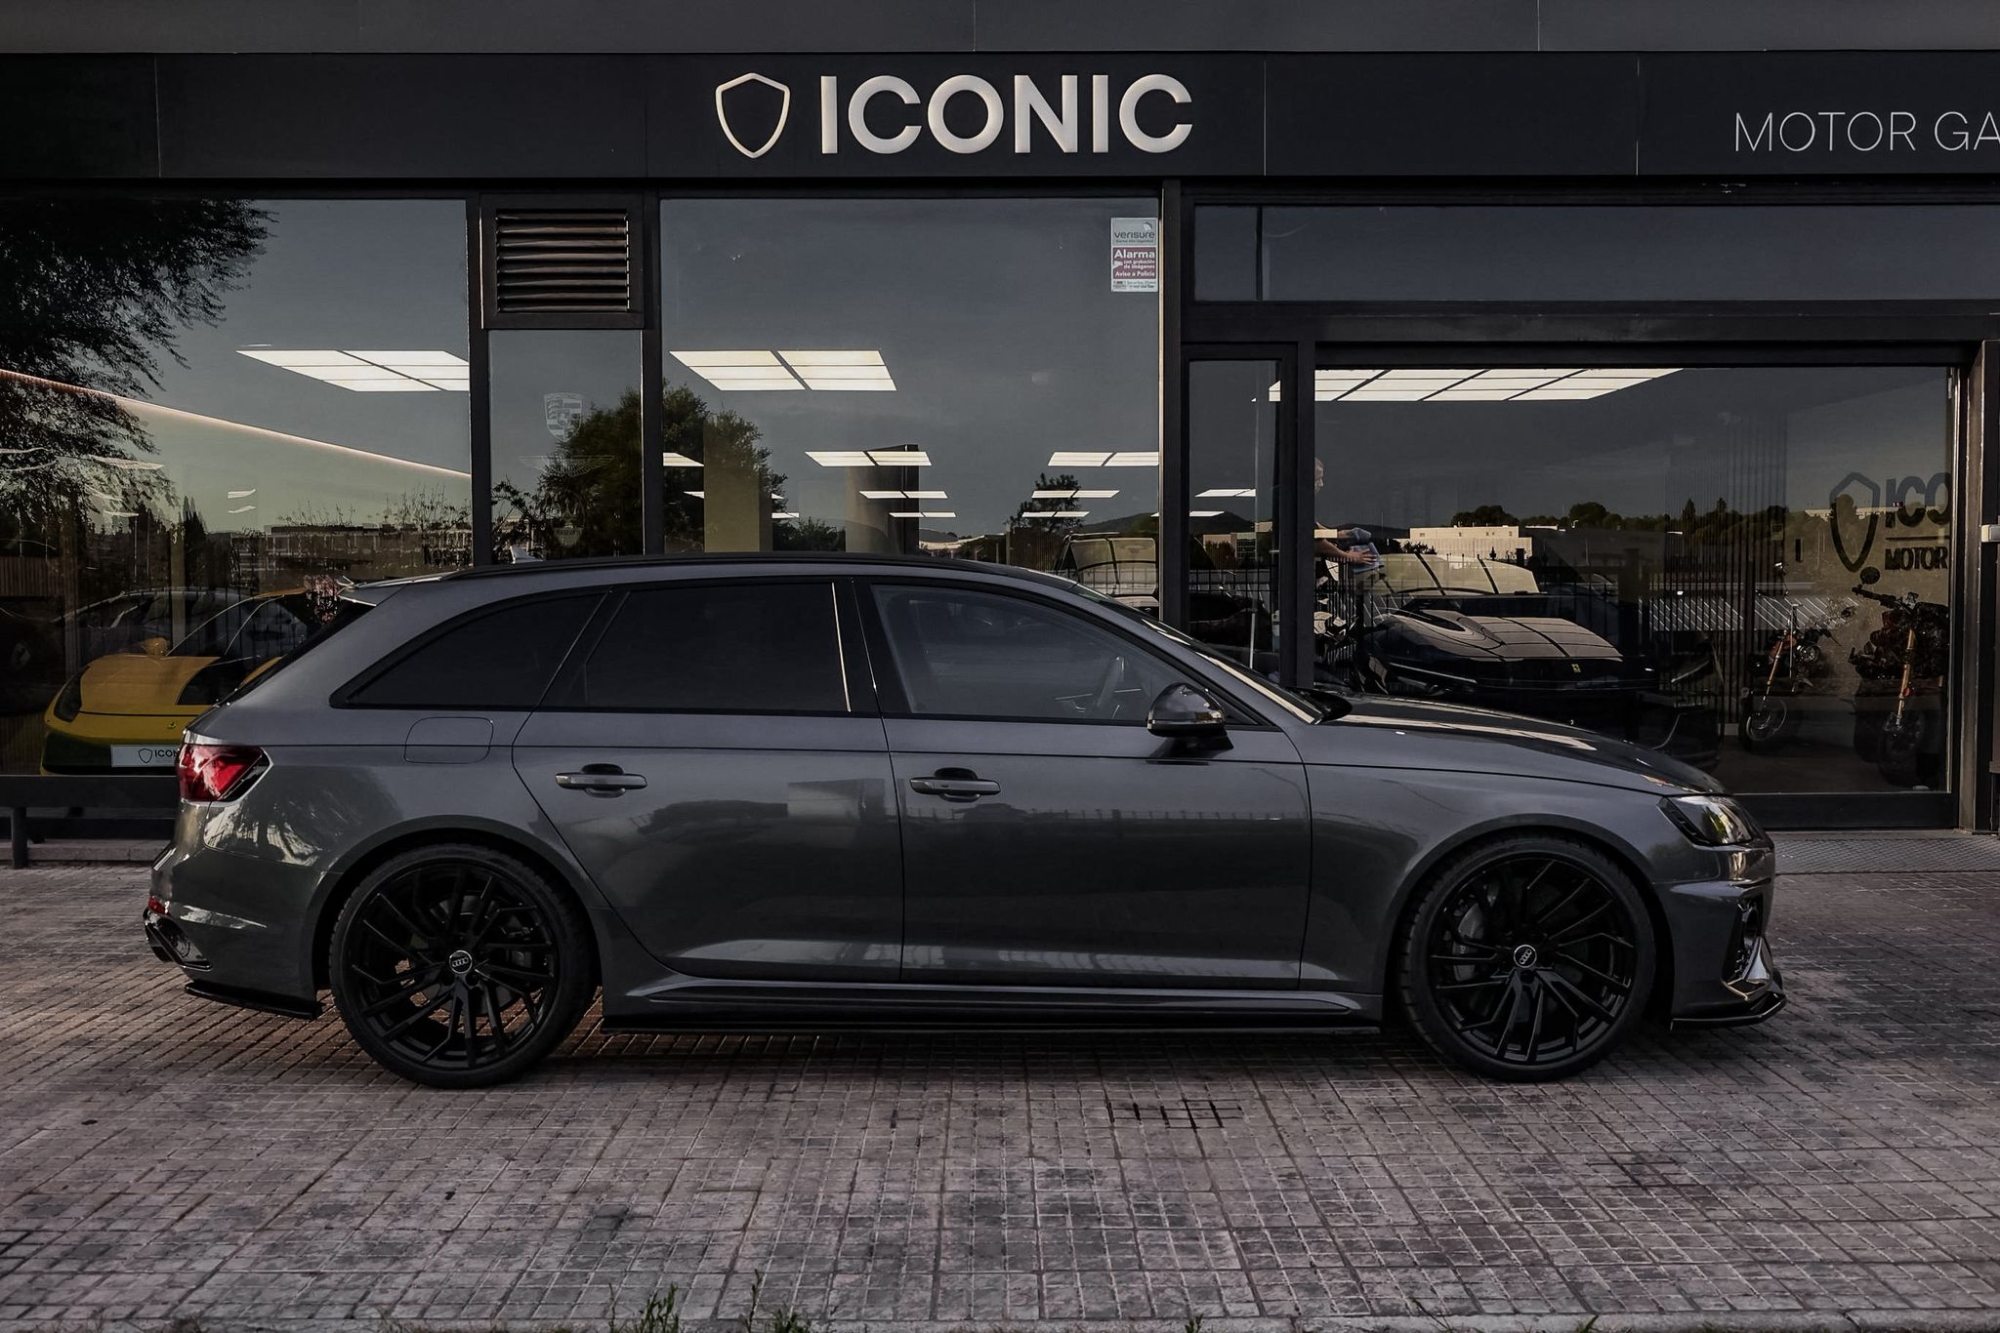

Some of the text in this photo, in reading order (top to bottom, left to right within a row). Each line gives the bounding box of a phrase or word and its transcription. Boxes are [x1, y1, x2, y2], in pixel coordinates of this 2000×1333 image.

[820, 73, 1193, 154] ICONIC
[1735, 111, 2000, 151] MOTOR GA
[1114, 249, 1155, 258] Alarma
[1885, 546, 1948, 571] MOTOR
